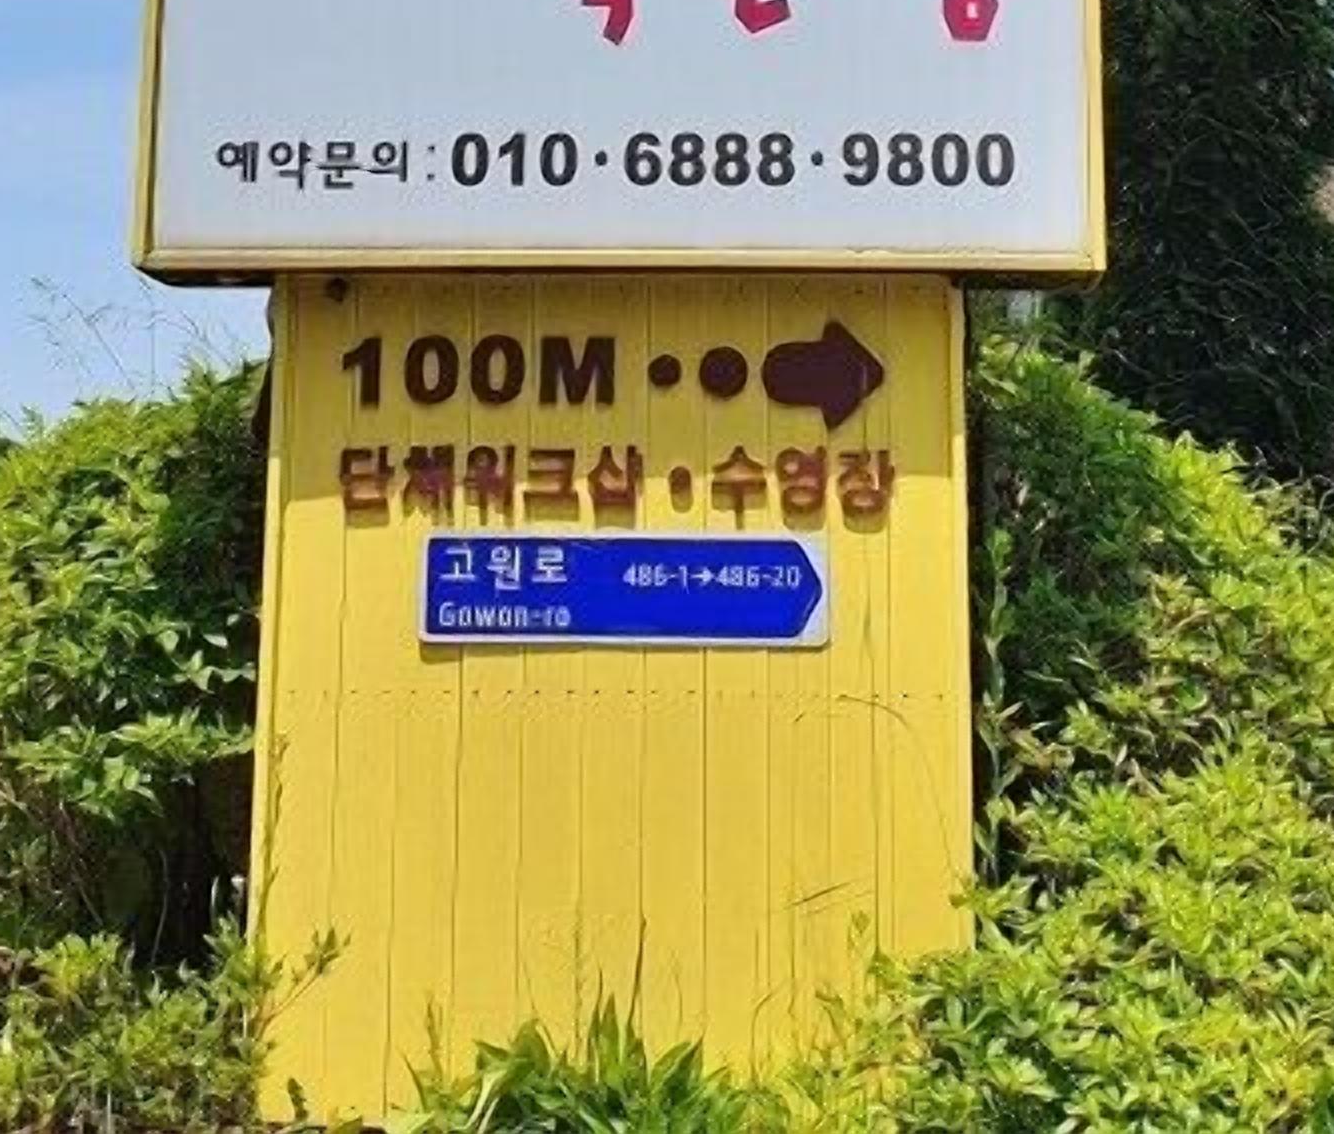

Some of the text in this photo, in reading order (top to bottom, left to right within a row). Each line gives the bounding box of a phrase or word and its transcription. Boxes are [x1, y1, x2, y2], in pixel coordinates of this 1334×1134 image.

[342, 334, 616, 407] 100M
[439, 545, 567, 591] 고원로
[438, 601, 571, 628] Gowon-ro
